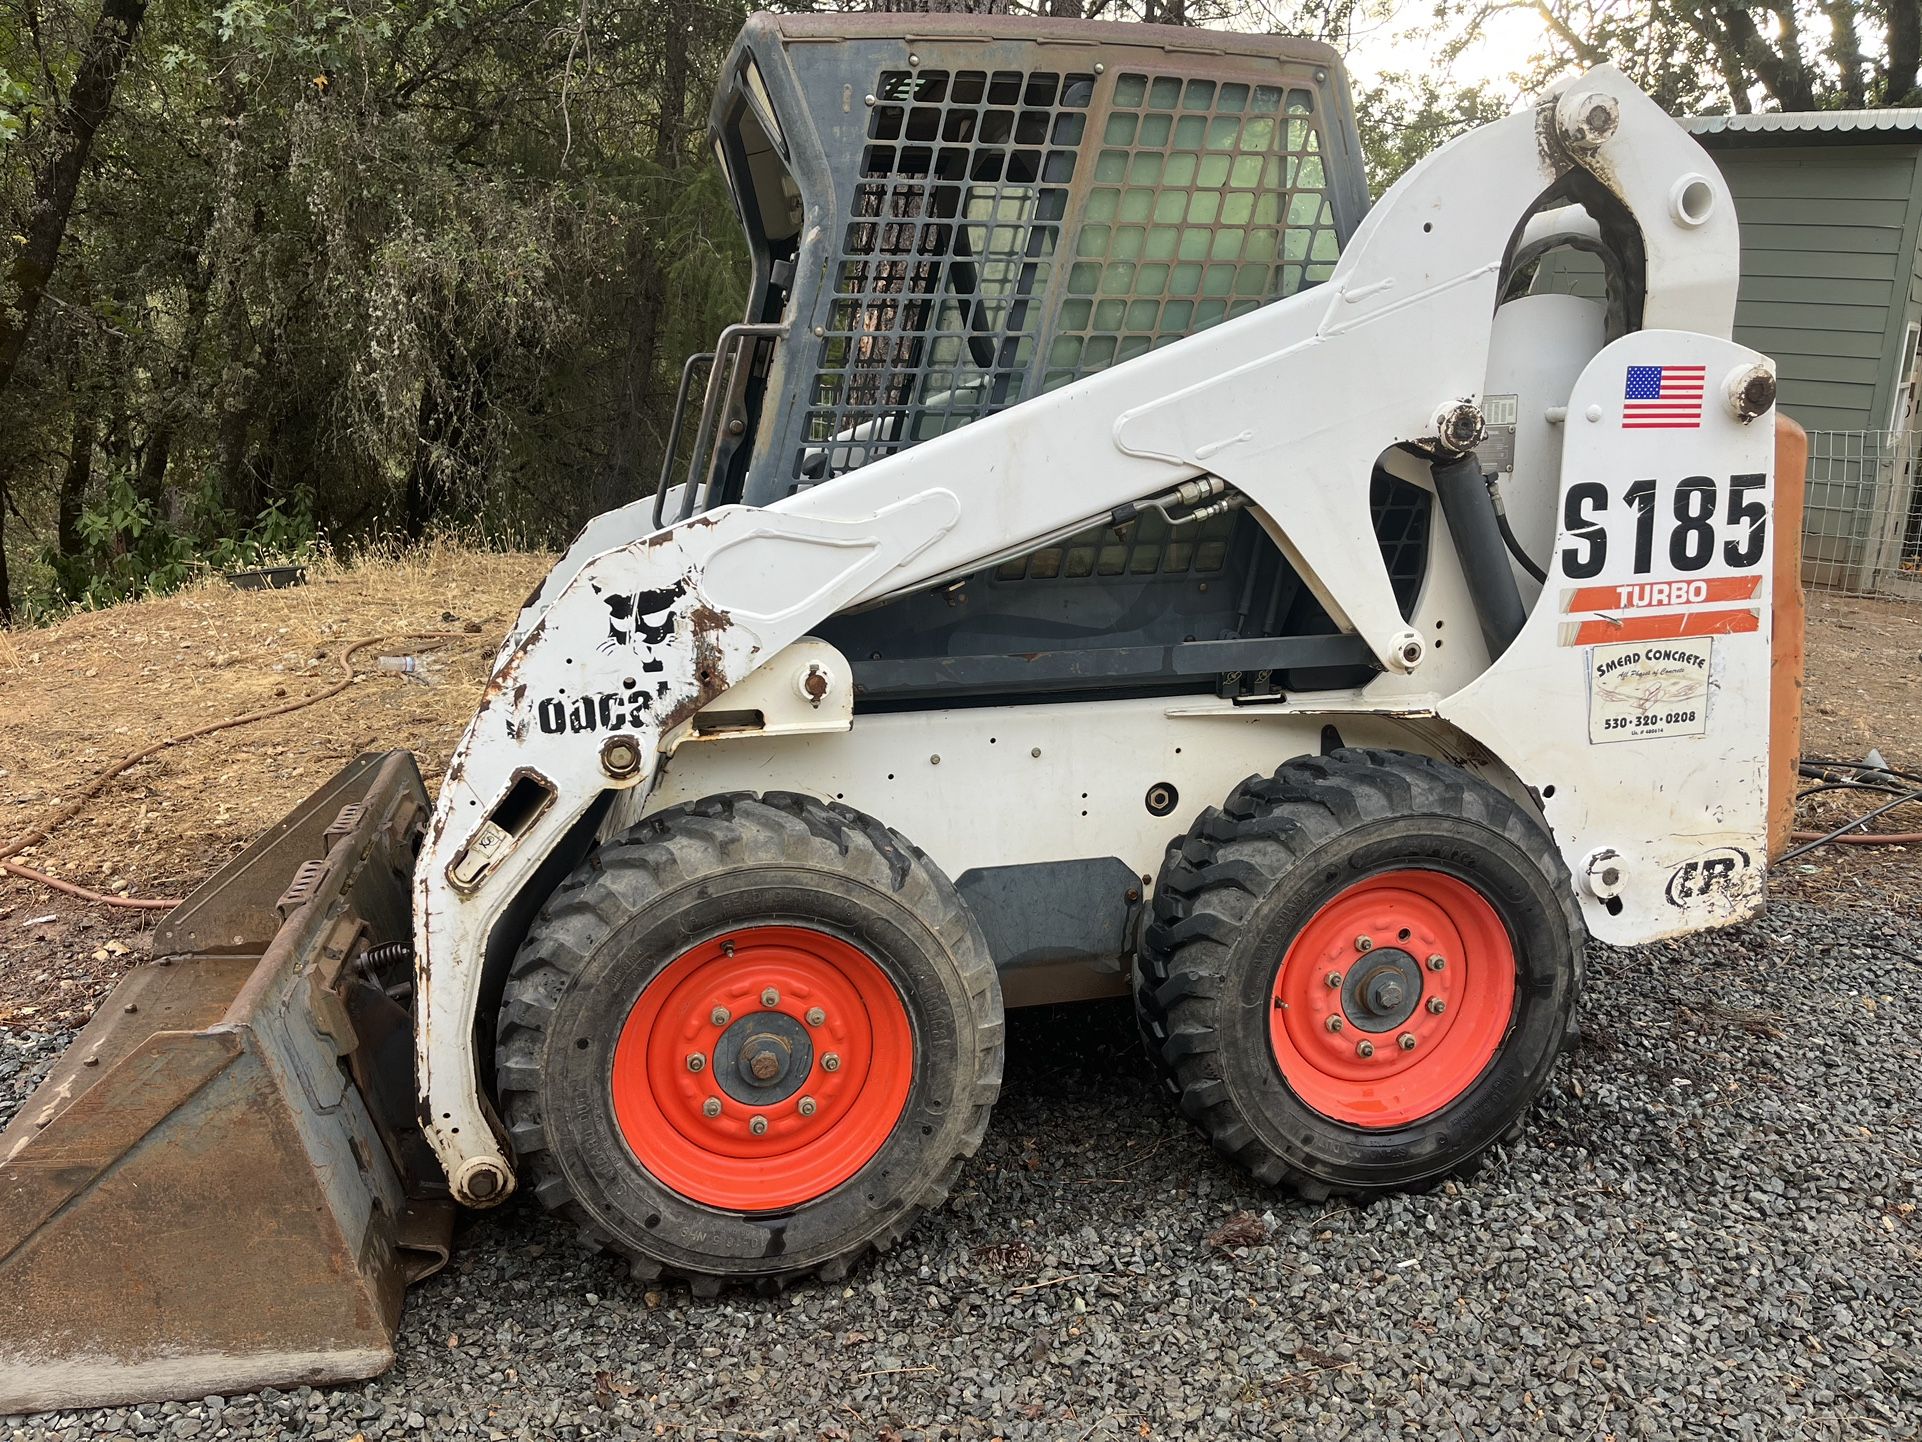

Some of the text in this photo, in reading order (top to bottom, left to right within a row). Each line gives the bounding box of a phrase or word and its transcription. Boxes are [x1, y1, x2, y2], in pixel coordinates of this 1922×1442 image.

[1562, 473, 1767, 580] S185
[1616, 580, 1708, 609] TURBO
[1596, 648, 1706, 678] SMEAD CONCRETE
[1652, 668, 1659, 677] of
[1659, 667, 1685, 676] Concrete
